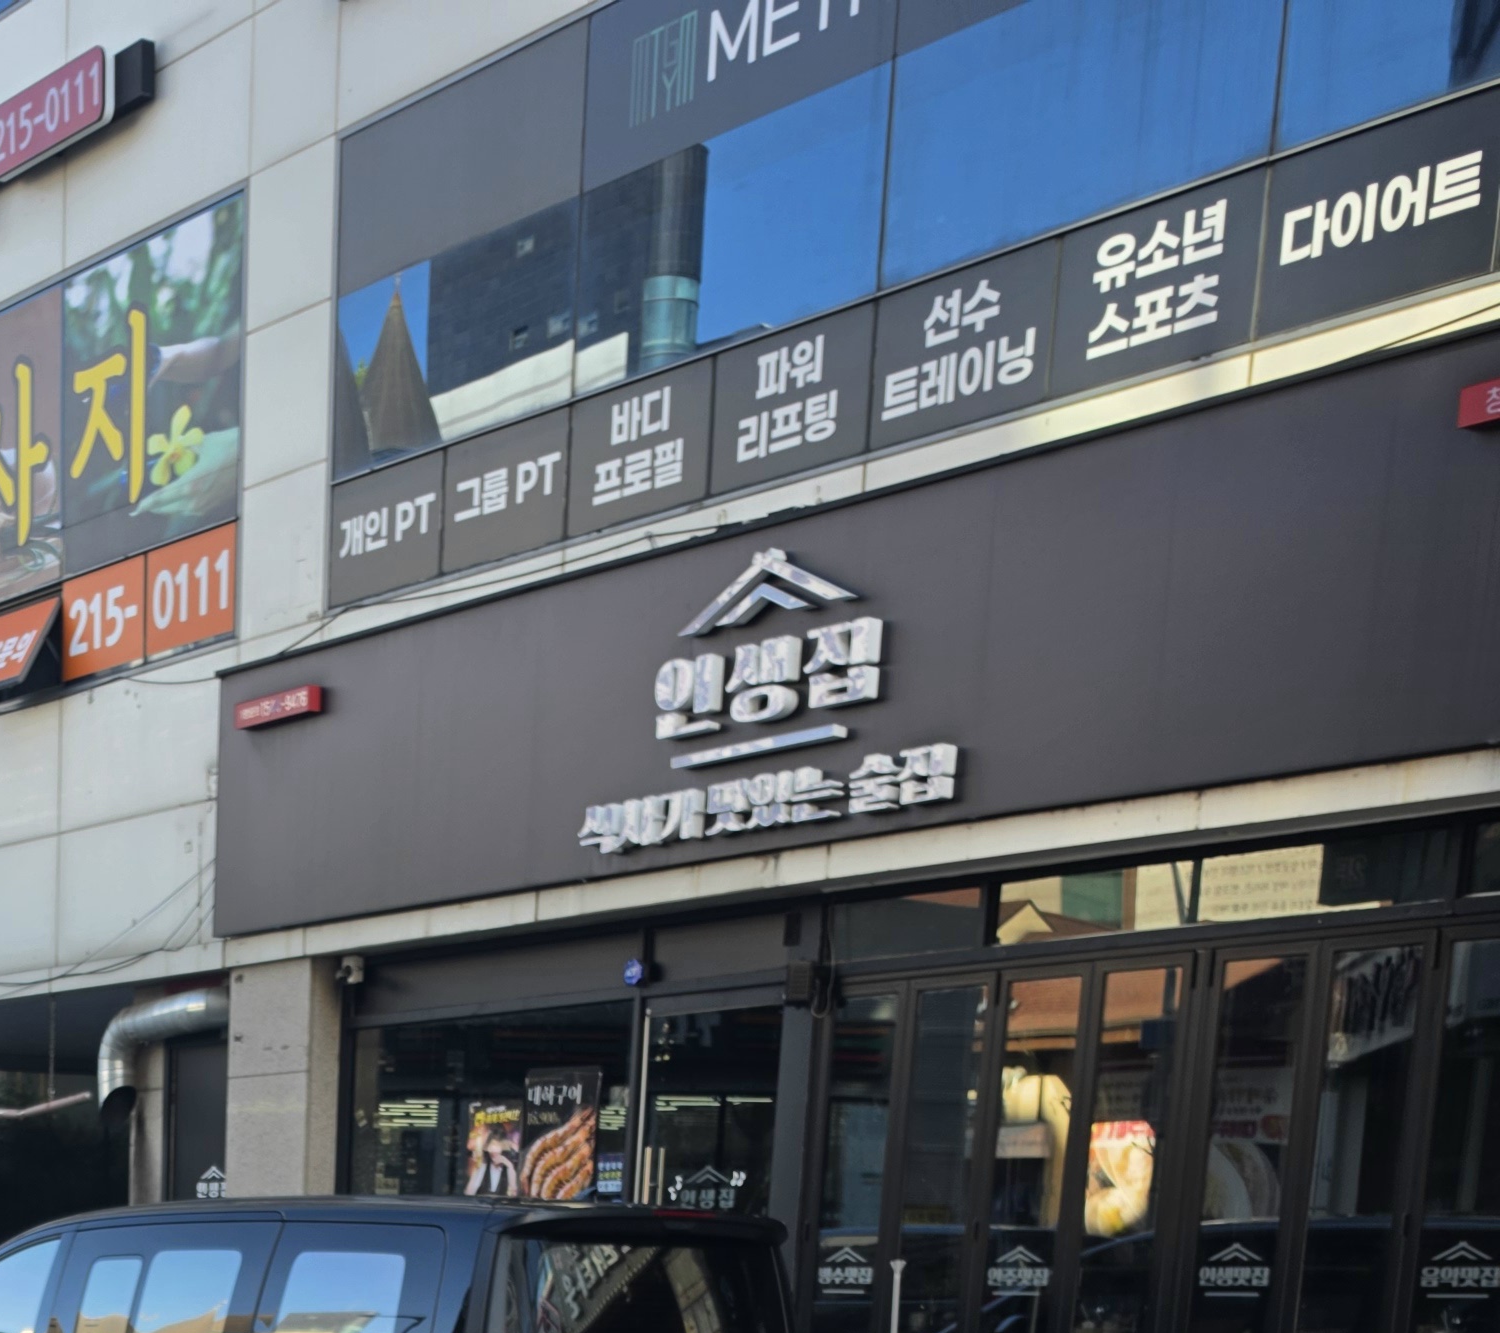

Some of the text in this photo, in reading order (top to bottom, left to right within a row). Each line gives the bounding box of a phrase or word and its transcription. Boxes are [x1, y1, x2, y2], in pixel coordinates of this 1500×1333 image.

[707, 0, 859, 83] ME
[1091, 199, 1229, 289] 유소년
[1279, 149, 1484, 268] 다이어트
[923, 279, 1002, 350] 선수
[1086, 273, 1220, 361] 스포츠
[756, 334, 825, 400] 파워
[881, 326, 1037, 423] 트레이닝
[610, 386, 672, 448] 바디
[736, 389, 838, 463] 리프팅
[454, 451, 561, 524] 그룹 PT
[592, 437, 685, 506] 프로필
[339, 492, 436, 559] 개인 PT
[654, 616, 883, 741] 인생집
[704, 766, 845, 838] 맛있는
[848, 742, 959, 815] 술집
